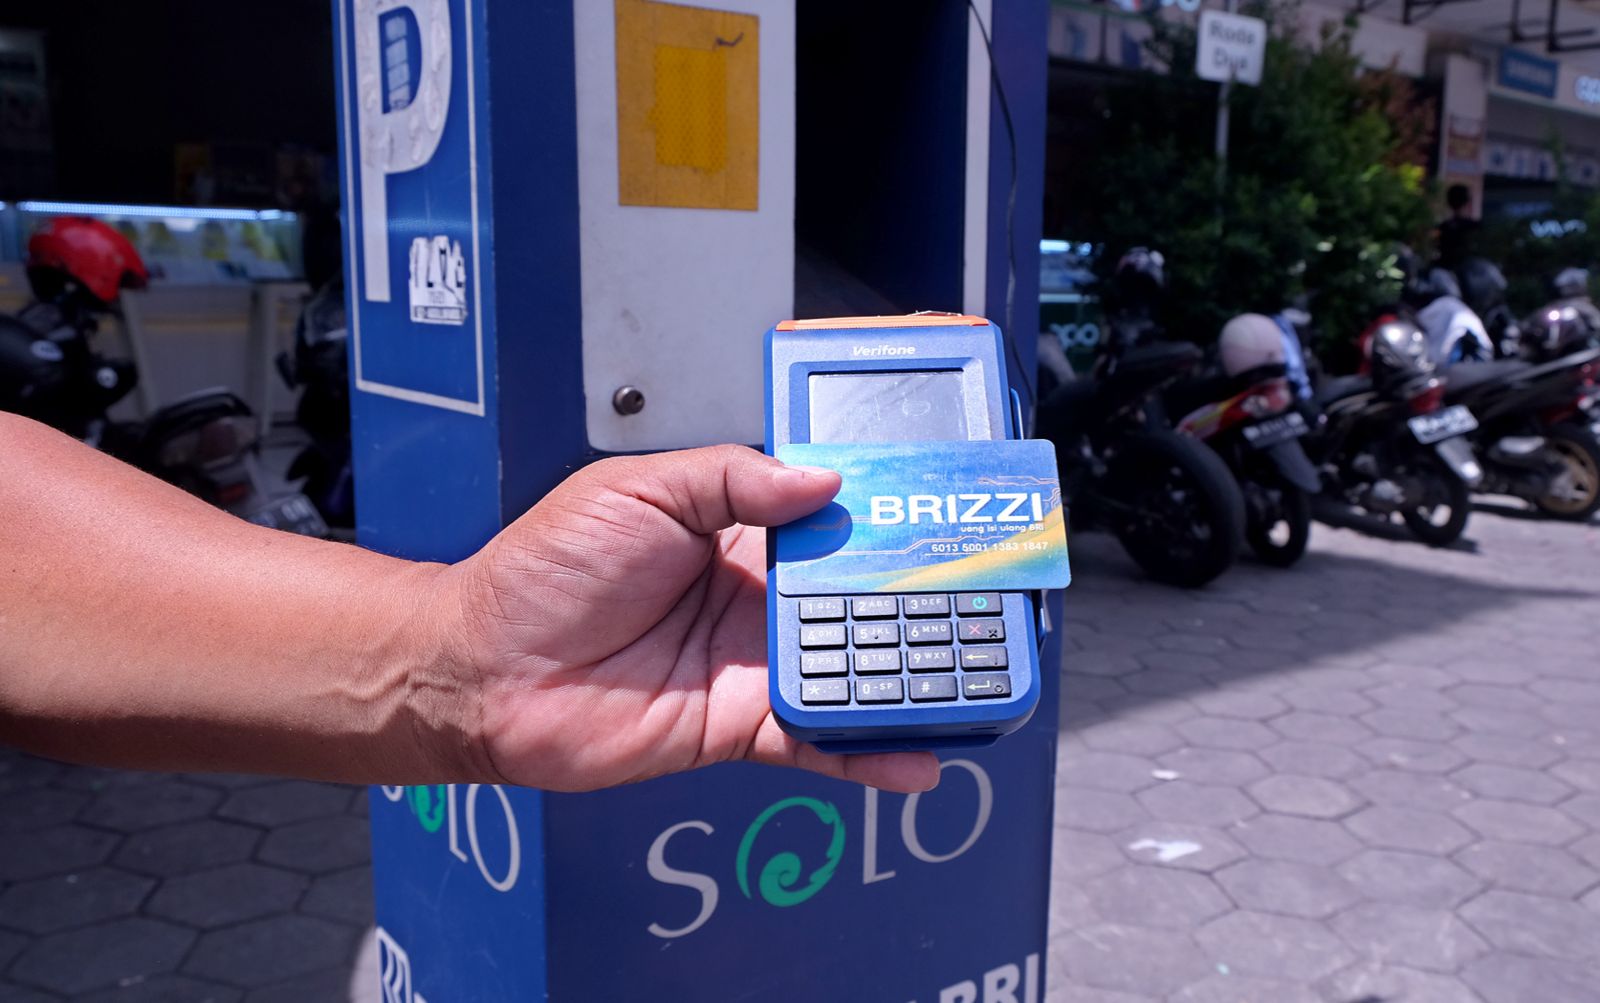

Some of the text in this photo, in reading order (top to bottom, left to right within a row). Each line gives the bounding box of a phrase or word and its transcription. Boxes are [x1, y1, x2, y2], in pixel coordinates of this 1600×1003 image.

[355, 0, 452, 302] P
[853, 344, 916, 356] Verifone
[870, 493, 1044, 525] BRIZZI
[960, 524, 984, 534] uang
[1000, 523, 1026, 533] ulang
[931, 543, 959, 553] 6013
[962, 543, 988, 552] 5001
[1023, 541, 1049, 551] 1847
[808, 603, 814, 614] 1
[858, 602, 866, 611] 2
[910, 599, 918, 609] 3
[860, 627, 890, 639] 5 JKL
[911, 626, 919, 637] 6
[807, 658, 815, 669] 7
[861, 653, 893, 666] 8 TUV
[914, 653, 921, 664] 9
[862, 684, 870, 694] 0
